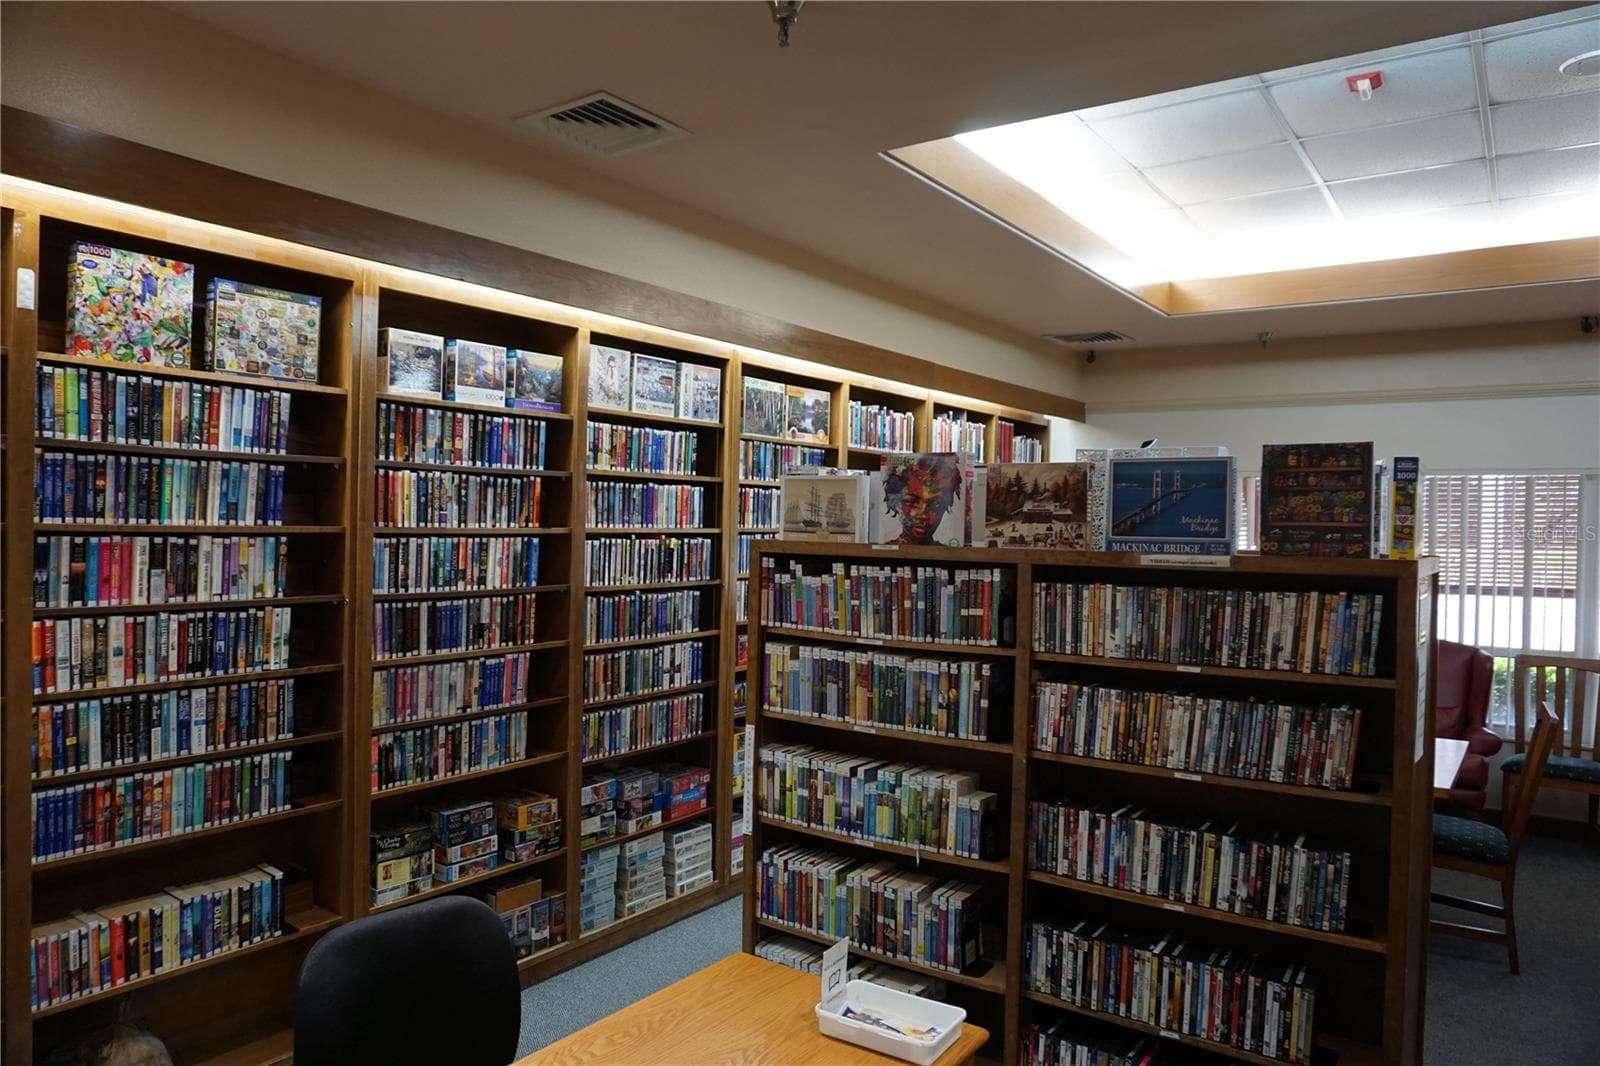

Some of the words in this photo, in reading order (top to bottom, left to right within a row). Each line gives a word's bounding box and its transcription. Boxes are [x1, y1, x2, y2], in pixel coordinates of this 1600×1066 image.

[89, 246, 111, 257] 1000
[1190, 523, 1219, 535] Bridge
[1111, 542, 1160, 553] MACKINAC
[1163, 543, 1201, 554] BRIDGE
